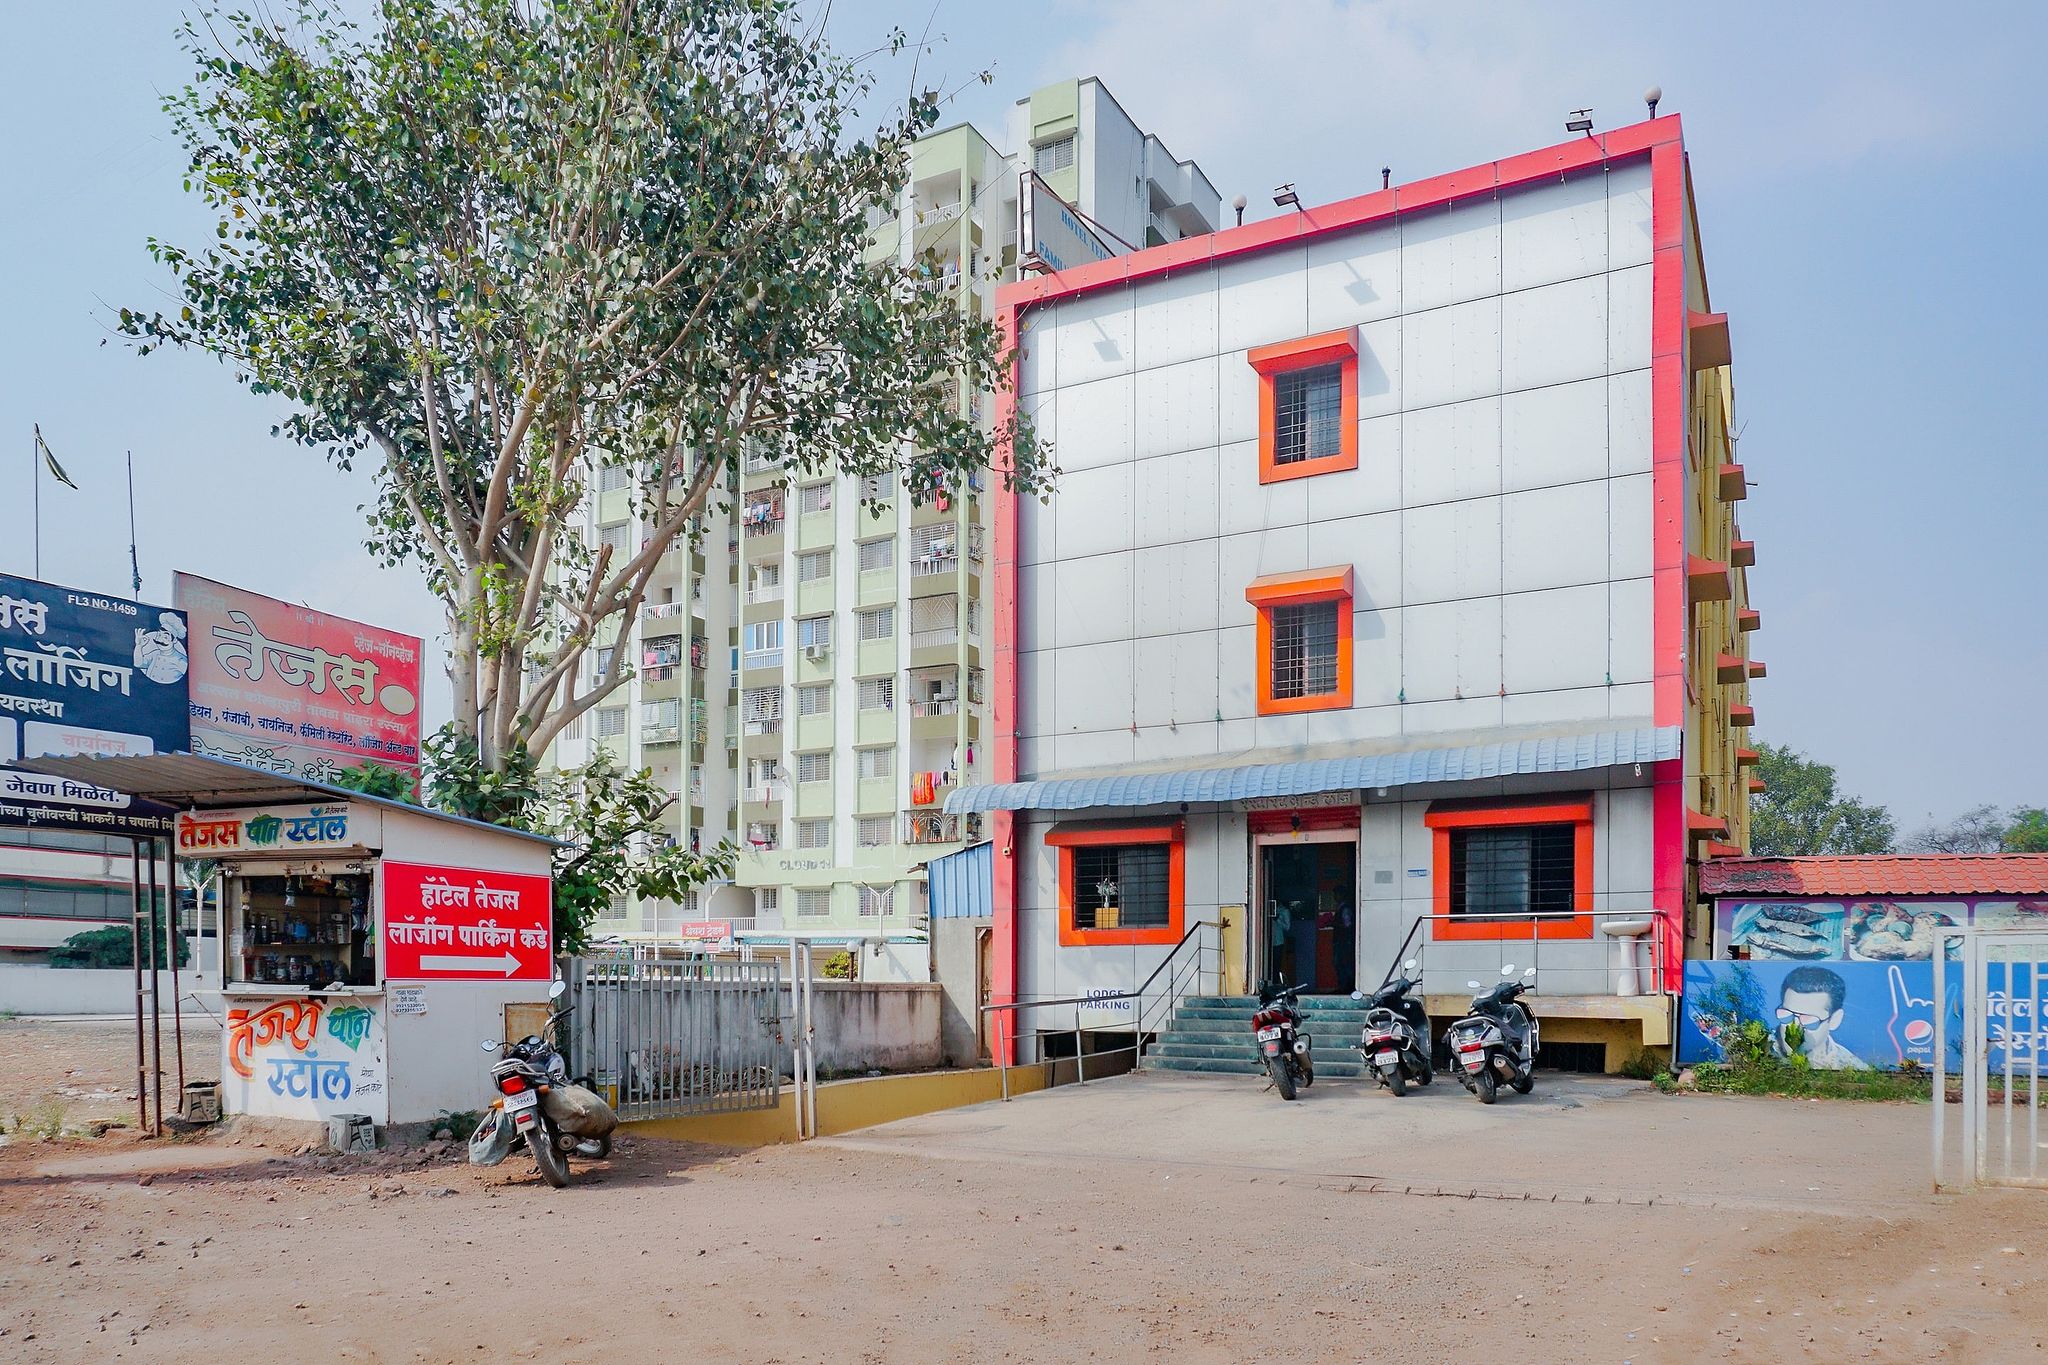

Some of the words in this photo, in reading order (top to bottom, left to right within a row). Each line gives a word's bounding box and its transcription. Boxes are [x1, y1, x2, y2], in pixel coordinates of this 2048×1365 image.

[1061, 209, 1089, 247] HOTEL
[1039, 240, 1069, 271] FAMIL
[68, 594, 89, 607] FL3
[92, 598, 137, 616] NO.1459
[3, 640, 133, 698] लॉजिंग
[211, 610, 381, 705] तेजस
[6, 775, 56, 796] जेवण
[179, 815, 241, 849] तेजस
[285, 807, 349, 843] स्टॉल
[420, 876, 470, 910] हॉटेल
[474, 880, 520, 911] तेजस
[520, 921, 548, 950] कडे
[1080, 1001, 1130, 1010] PARKING
[227, 999, 324, 1080] तेजस
[1907, 1046, 1932, 1055] pepsi
[266, 1049, 353, 1101] स्टॉल
